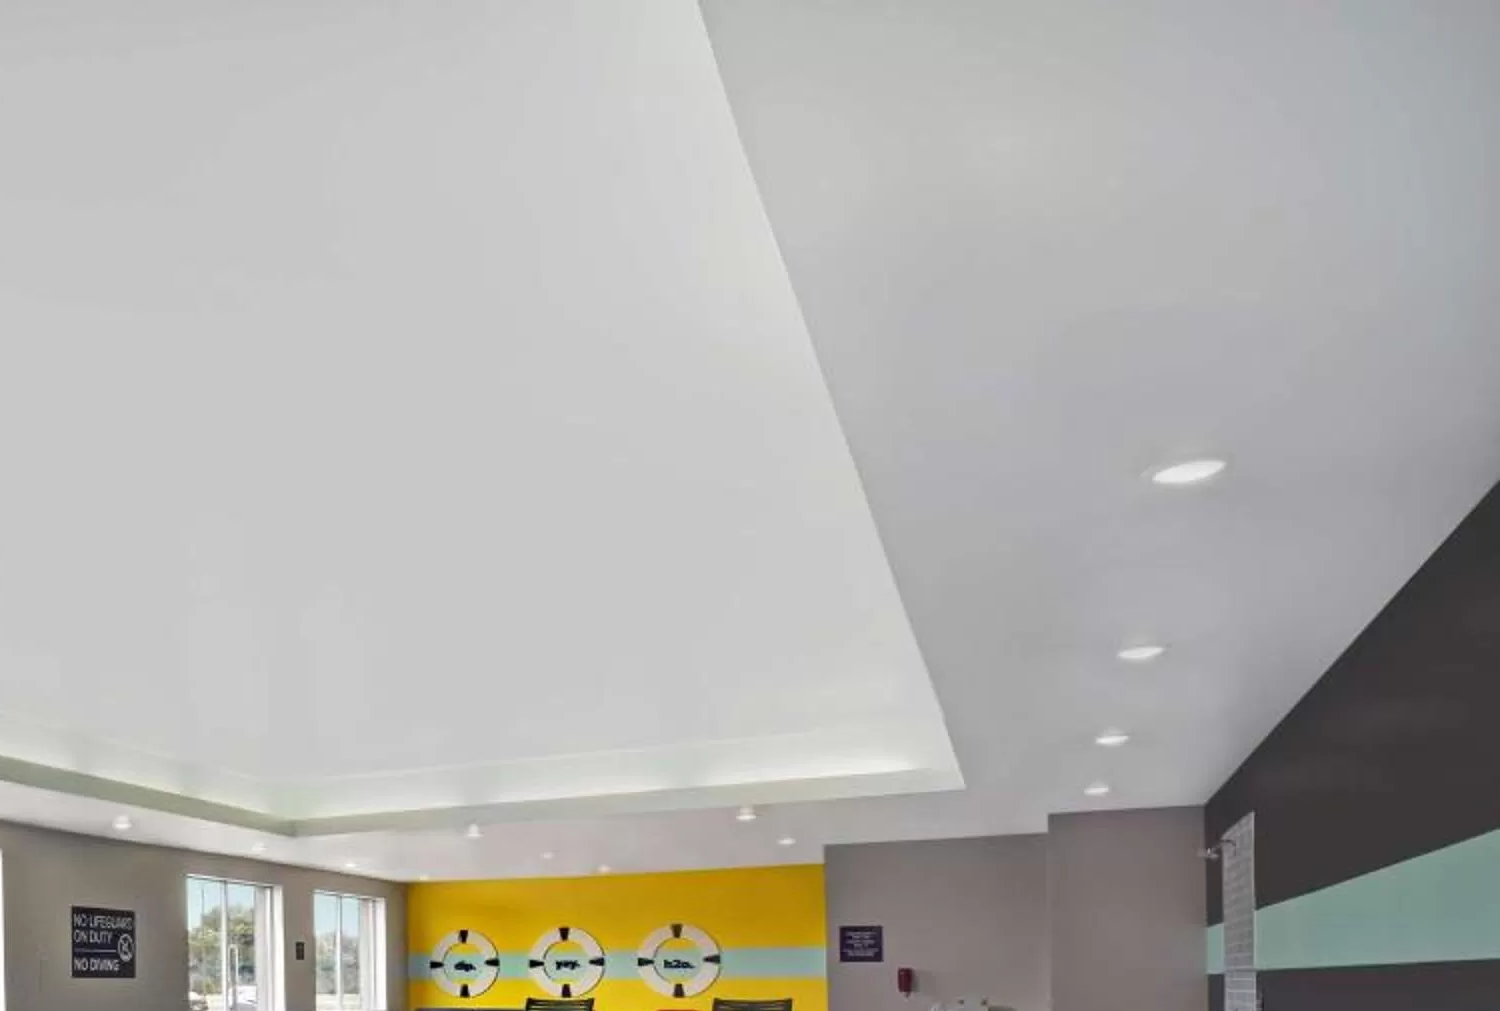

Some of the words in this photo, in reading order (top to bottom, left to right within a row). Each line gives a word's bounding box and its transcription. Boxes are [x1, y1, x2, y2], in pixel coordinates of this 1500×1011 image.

[74, 913, 88, 927] NO
[74, 930, 88, 944] ON
[90, 930, 113, 944] DUTY
[74, 956, 88, 970] NO
[90, 958, 120, 972] DIVING
